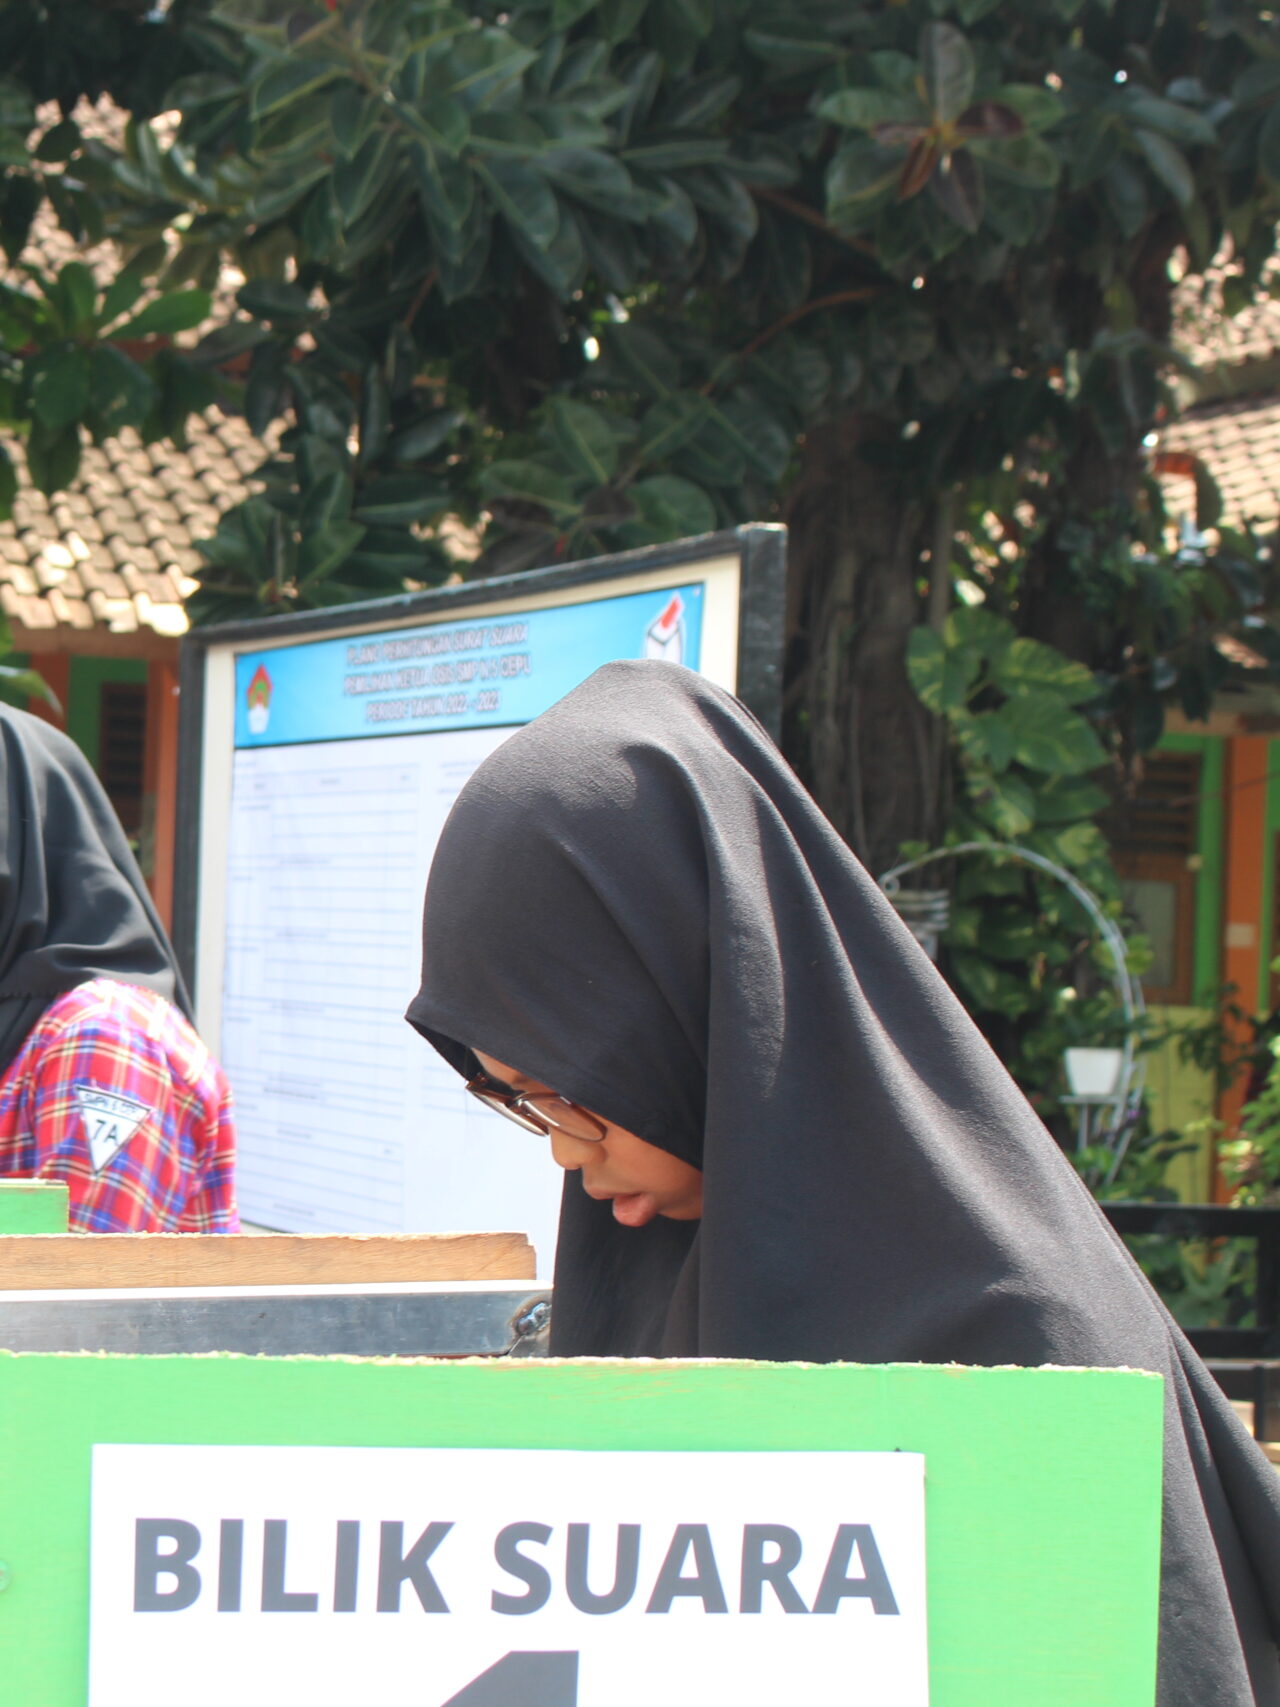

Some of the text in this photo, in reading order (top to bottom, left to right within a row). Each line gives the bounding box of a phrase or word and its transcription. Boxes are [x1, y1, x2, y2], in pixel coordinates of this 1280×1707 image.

[95, 1119, 119, 1142] 7A
[133, 1518, 900, 1615] BILIK SUARA
